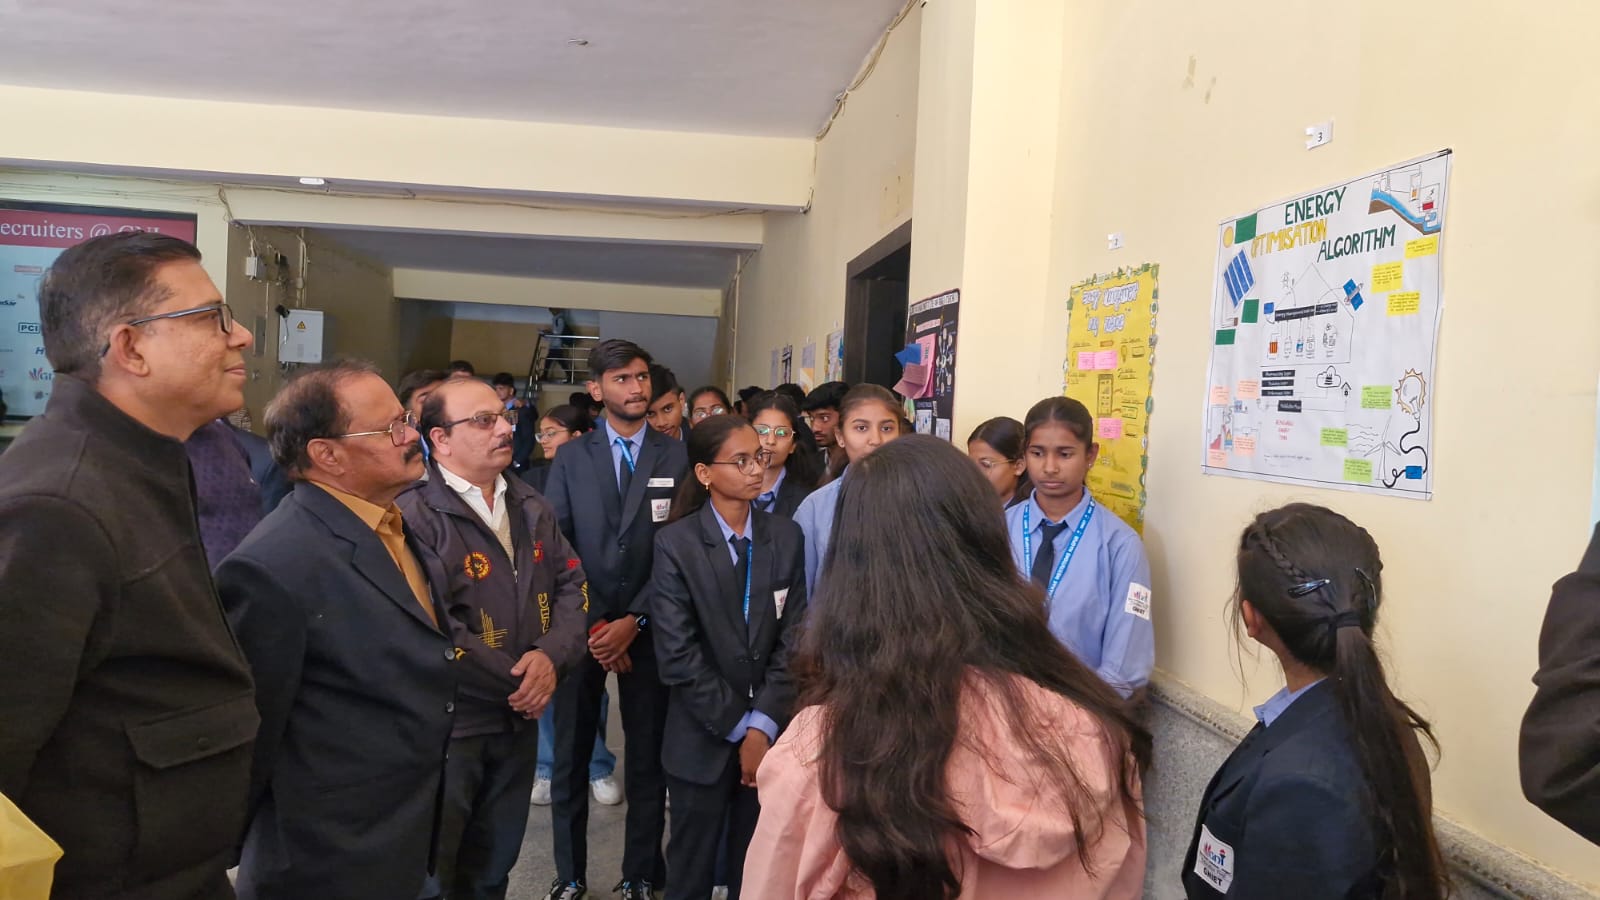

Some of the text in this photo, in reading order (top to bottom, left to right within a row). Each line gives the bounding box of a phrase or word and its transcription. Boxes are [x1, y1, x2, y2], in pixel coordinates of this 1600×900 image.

[1317, 131, 1323, 142] 3
[1285, 186, 1347, 225] ENERGY
[1316, 224, 1396, 263] ALGORITHM
[20, 323, 39, 332] PCI
[1203, 867, 1223, 886] GNIET
